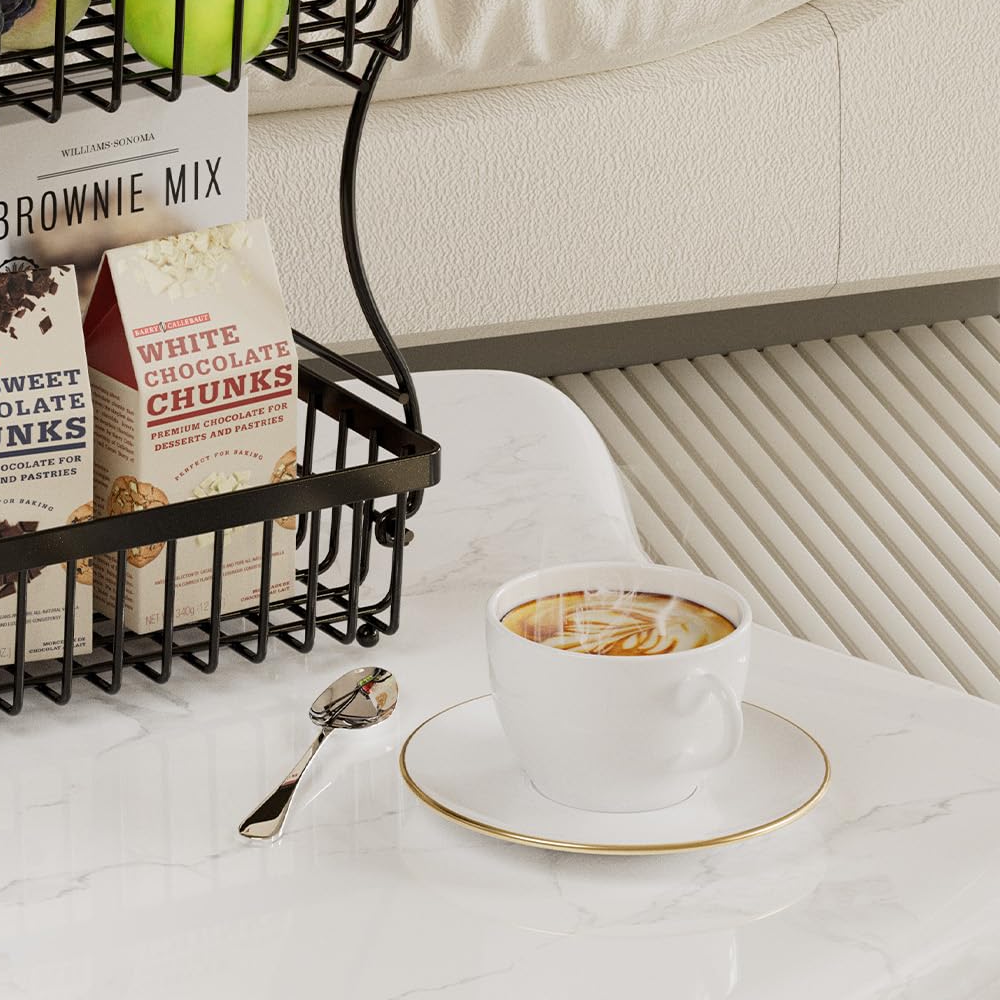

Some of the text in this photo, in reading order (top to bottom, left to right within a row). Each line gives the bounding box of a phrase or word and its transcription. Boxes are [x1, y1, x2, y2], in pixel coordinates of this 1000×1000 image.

[165, 157, 222, 207] MIX
[134, 313, 210, 338] BARRY CALLEBAUT
[136, 324, 240, 364] WHITE
[144, 340, 291, 388] CHOCOLATE
[146, 363, 293, 417] CHUNKS
[150, 420, 200, 441] PREMIUM
[203, 409, 265, 430] CHOCOLATE
[268, 402, 288, 414] FOR
[154, 433, 207, 452] DESSERTS
[210, 428, 232, 441] AND
[234, 415, 284, 435] PASTRIES
[20, 468, 77, 481] PASTRIES
[58, 455, 82, 465] FOR
[175, 449, 264, 482] PERFECT FOR BAKING
[19, 498, 55, 512] BAKING
[145, 613, 160, 625] NET
[175, 605, 195, 618] 340g
